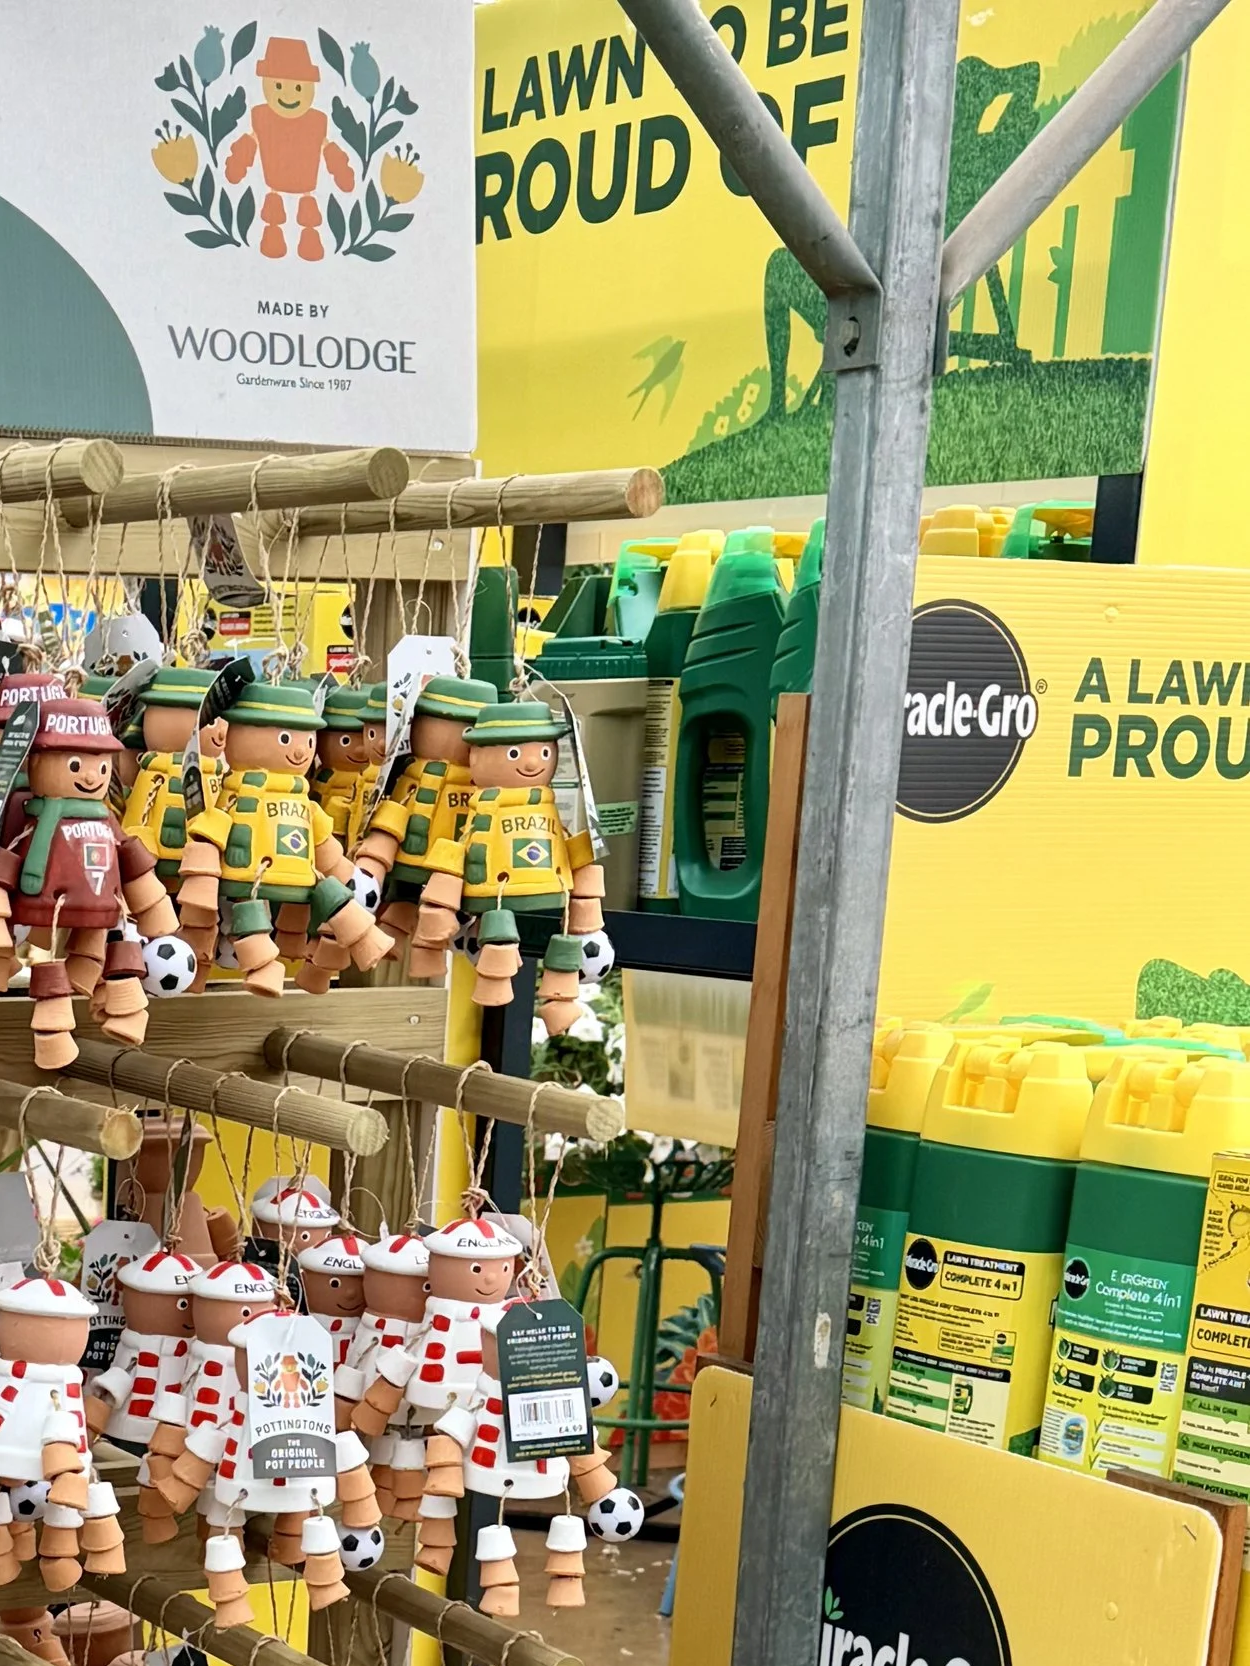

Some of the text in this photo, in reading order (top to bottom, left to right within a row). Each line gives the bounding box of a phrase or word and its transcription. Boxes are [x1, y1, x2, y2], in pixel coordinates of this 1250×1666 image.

[481, 0, 849, 133] LAWN BE
[257, 300, 329, 318] MADE BY
[168, 324, 417, 375] WOODLODGE
[236, 373, 352, 391] Gardenware Since 1987
[1074, 658, 1111, 702] A
[502, 816, 558, 835] BRAZIL
[91, 870, 105, 895] 7
[947, 1255, 1018, 1272] LAWN TREATMENT
[945, 1272, 1017, 1291] COMPLETE 4 1
[1096, 1281, 1181, 1308] Complete 4in1
[1200, 1308, 1227, 1320] LAWN
[86, 1351, 102, 1361] POT
[255, 1419, 331, 1436] POTTINGTONS
[272, 1448, 318, 1458] ORIGINAL
[265, 1459, 325, 1469] POT PEOPLE
